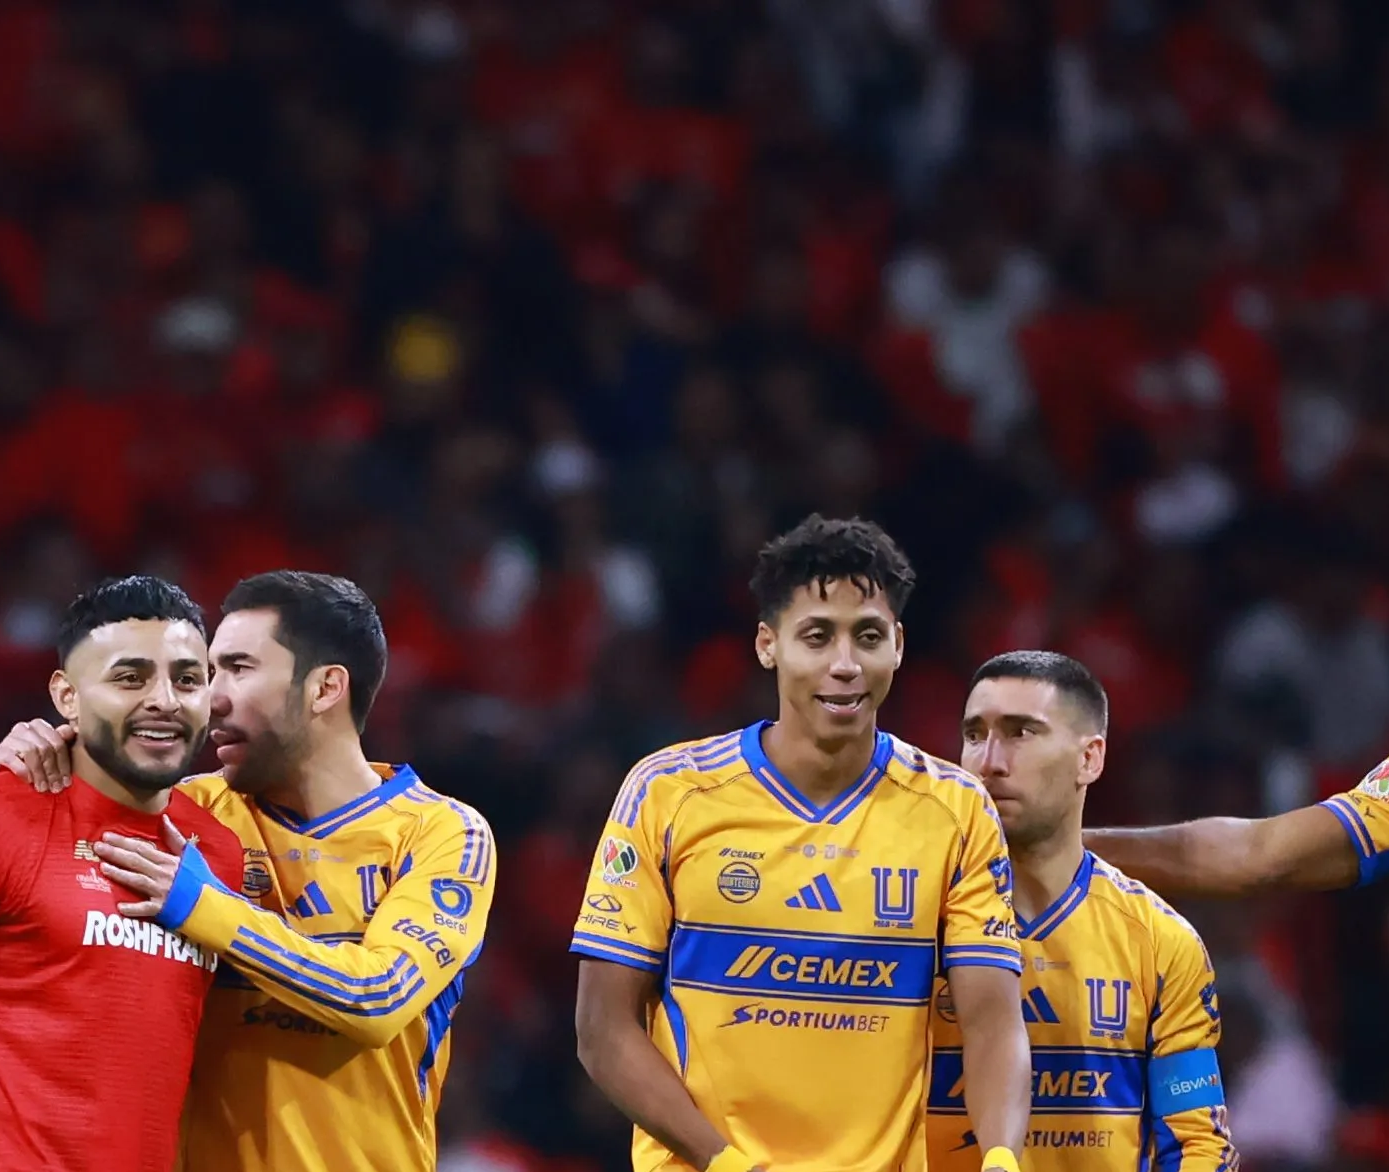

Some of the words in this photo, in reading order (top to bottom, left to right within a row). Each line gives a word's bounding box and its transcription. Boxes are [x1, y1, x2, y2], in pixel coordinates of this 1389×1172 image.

[730, 850, 765, 860] CEMEX
[433, 913, 468, 935] Berel
[392, 917, 456, 969] telcel
[770, 953, 899, 988] CEMEX
[716, 1001, 890, 1033] SPORTIUMBET
[1031, 1071, 1111, 1098] MEX
[1170, 1077, 1208, 1096] BBVA
